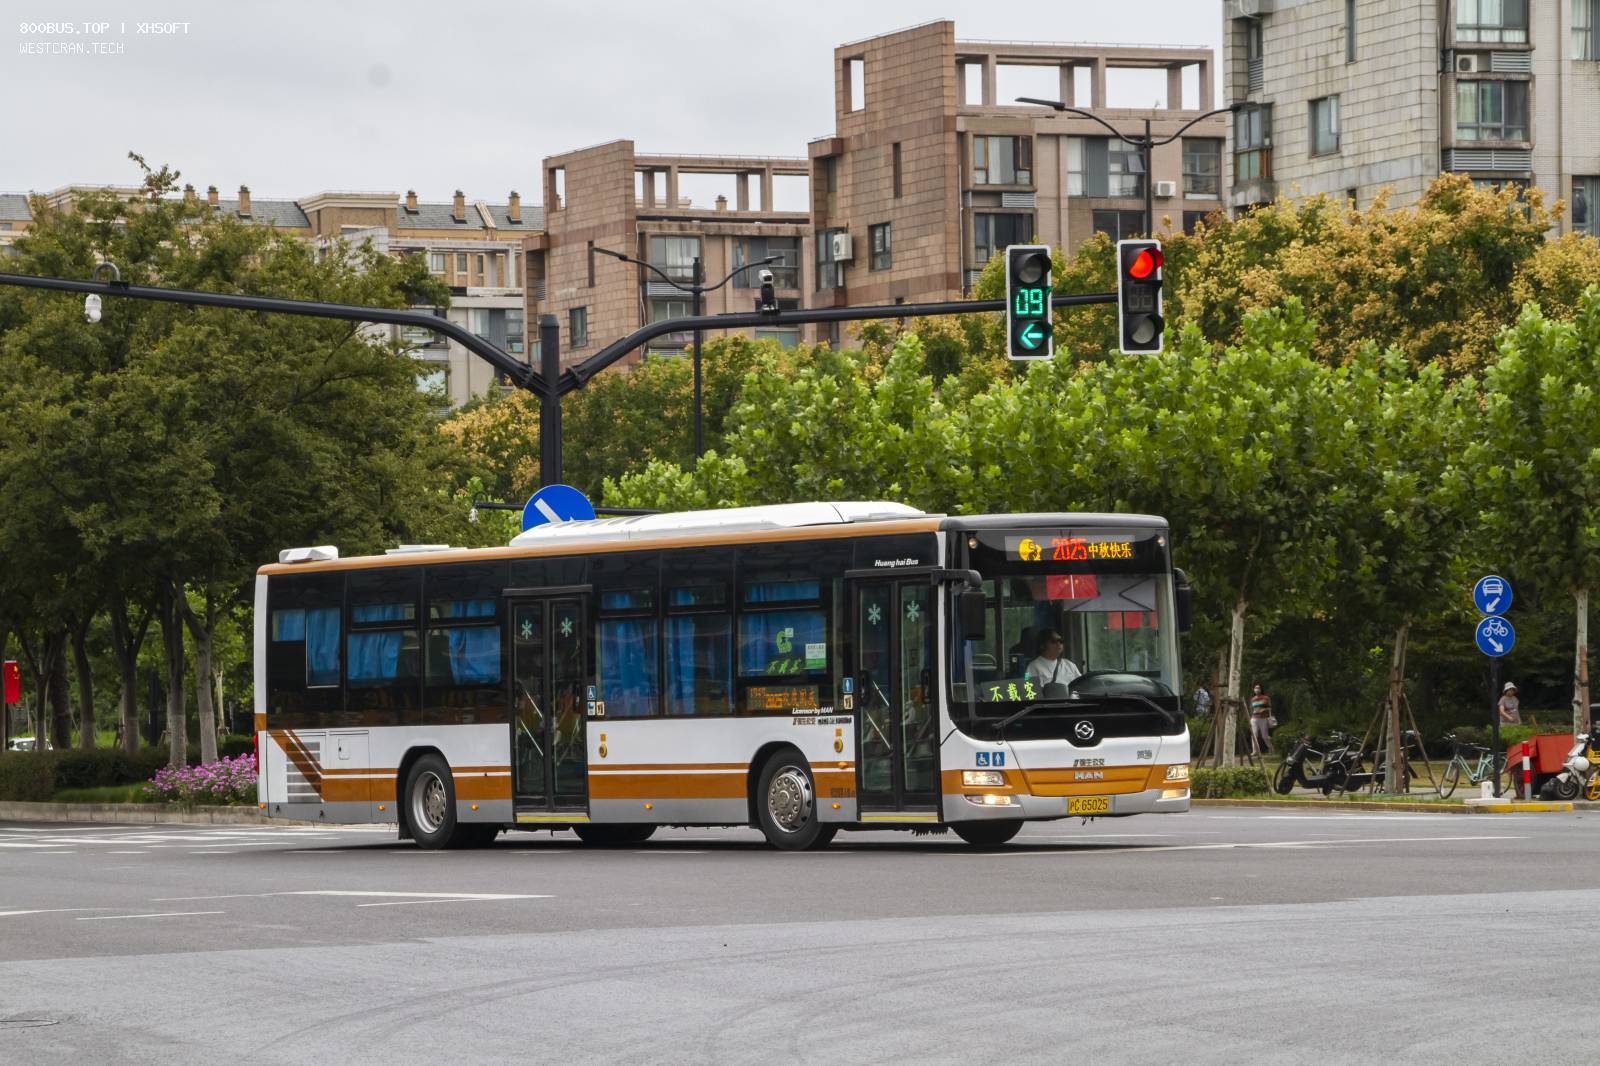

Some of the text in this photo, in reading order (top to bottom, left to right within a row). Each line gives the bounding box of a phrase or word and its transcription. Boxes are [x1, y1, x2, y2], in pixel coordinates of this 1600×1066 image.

[1015, 288, 1043, 315] 09
[1052, 538, 1088, 560] 2025
[1089, 542, 1132, 559] 中秋快乐
[989, 681, 1037, 702] 不载客
[1074, 771, 1104, 780] MAN
